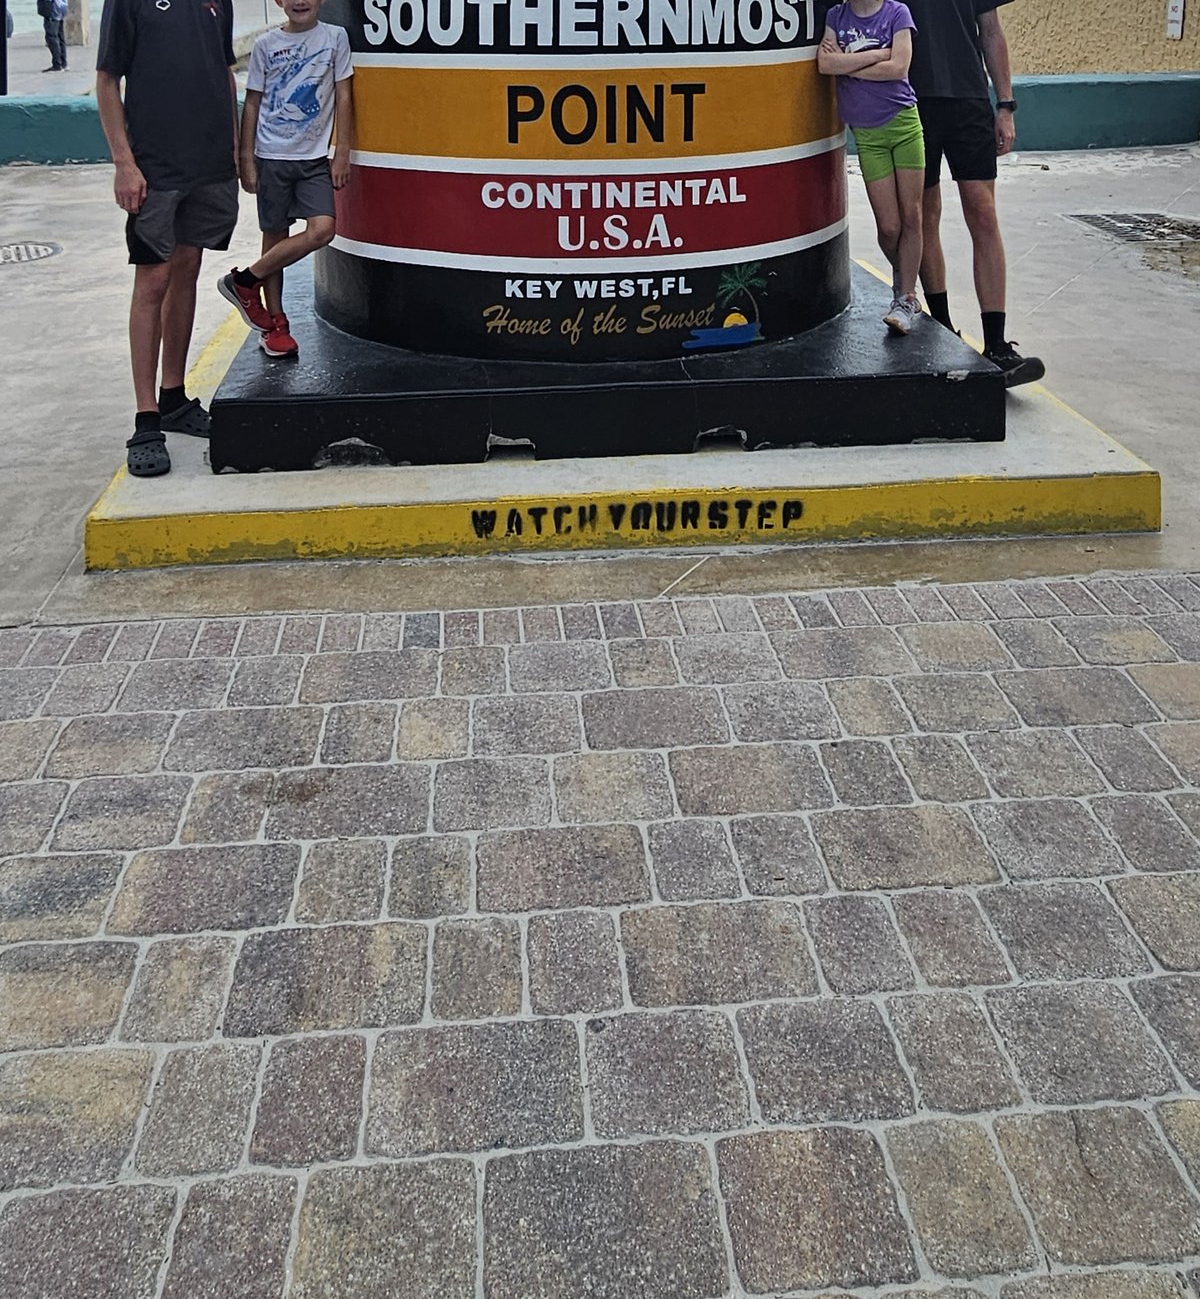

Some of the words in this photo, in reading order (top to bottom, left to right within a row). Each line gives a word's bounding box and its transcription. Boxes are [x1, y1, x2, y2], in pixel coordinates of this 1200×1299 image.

[507, 84, 705, 145] POINT
[481, 177, 746, 209] CONTINENTAL
[557, 213, 684, 251] U.S.A.
[505, 279, 562, 298] KEY
[482, 304, 551, 335] Home
[559, 305, 586, 345] of
[592, 303, 627, 335] the
[636, 302, 715, 334] Sunset
[473, 505, 597, 538] WATCH
[609, 501, 699, 532] YOUR
[707, 499, 803, 530] STEP
